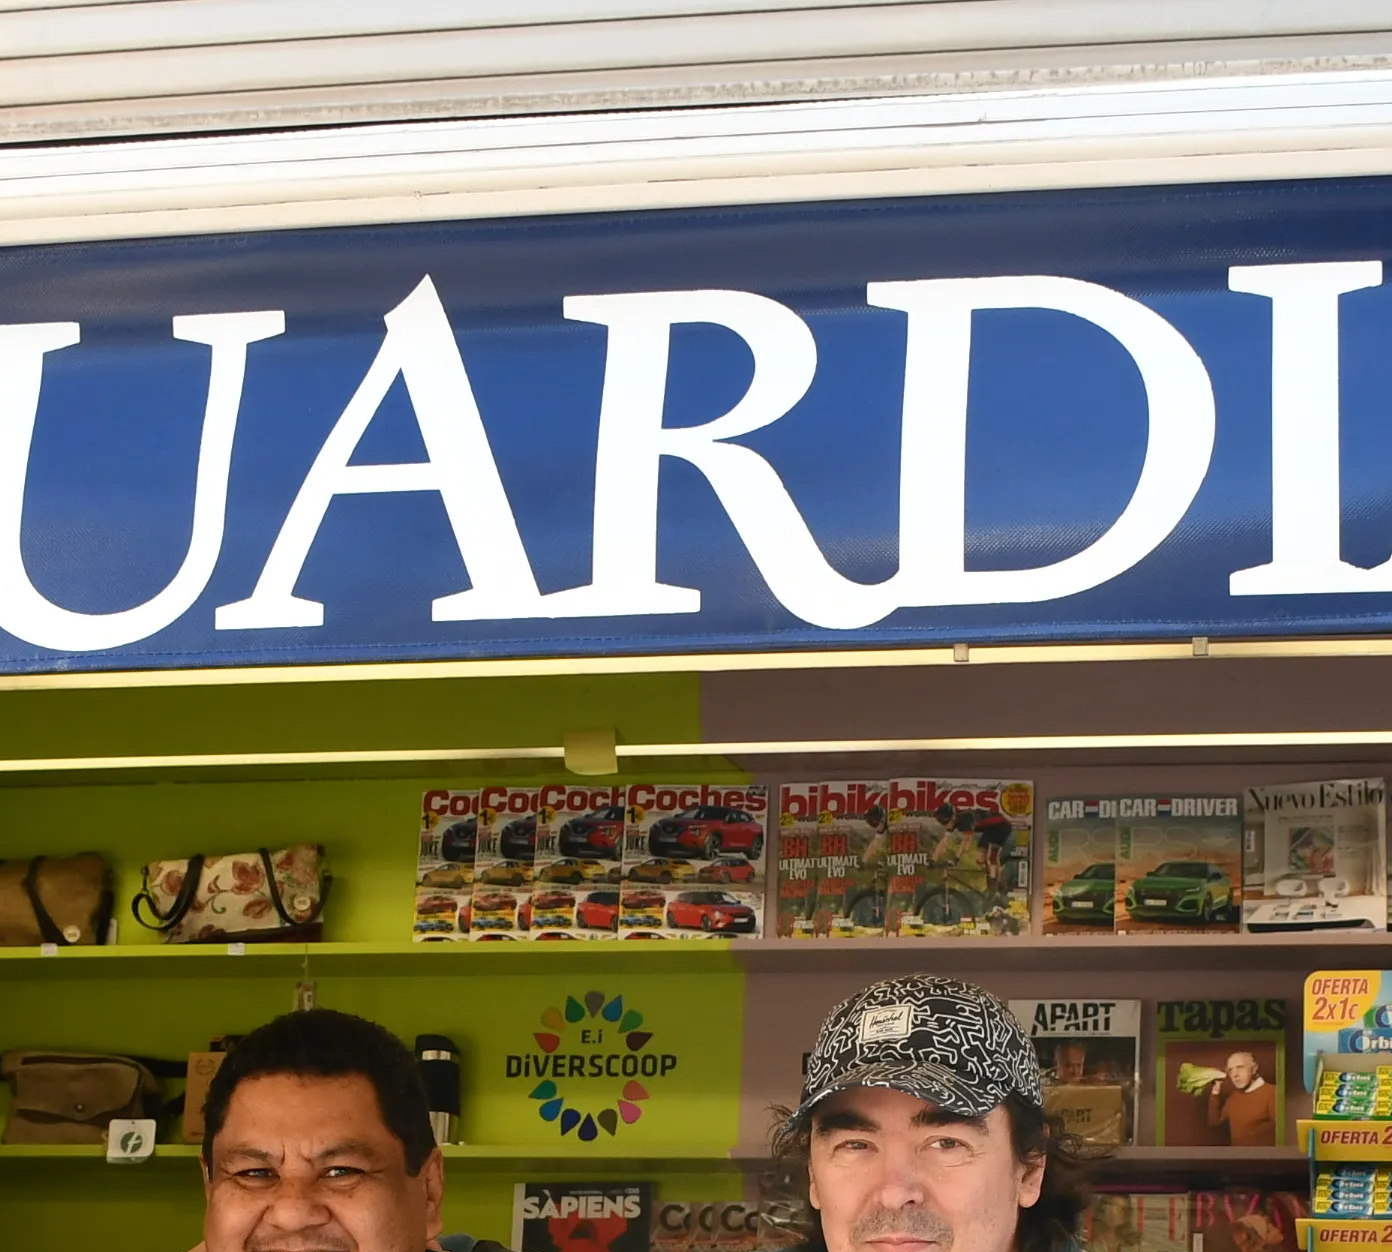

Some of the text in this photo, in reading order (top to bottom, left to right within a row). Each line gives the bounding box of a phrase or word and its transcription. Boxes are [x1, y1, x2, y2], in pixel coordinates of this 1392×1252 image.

[628, 783, 768, 812] Coches
[889, 780, 1000, 813] bikes
[1120, 797, 1238, 817] CAR DRIVER
[1249, 781, 1386, 811] Nuevo Estilo
[1312, 978, 1369, 995] OFERTA
[1158, 1000, 1286, 1037] Tapas
[1321, 1129, 1379, 1145] OFERTA
[521, 1188, 642, 1220] SÀPIENS
[1320, 1227, 1377, 1243] OFERTA
